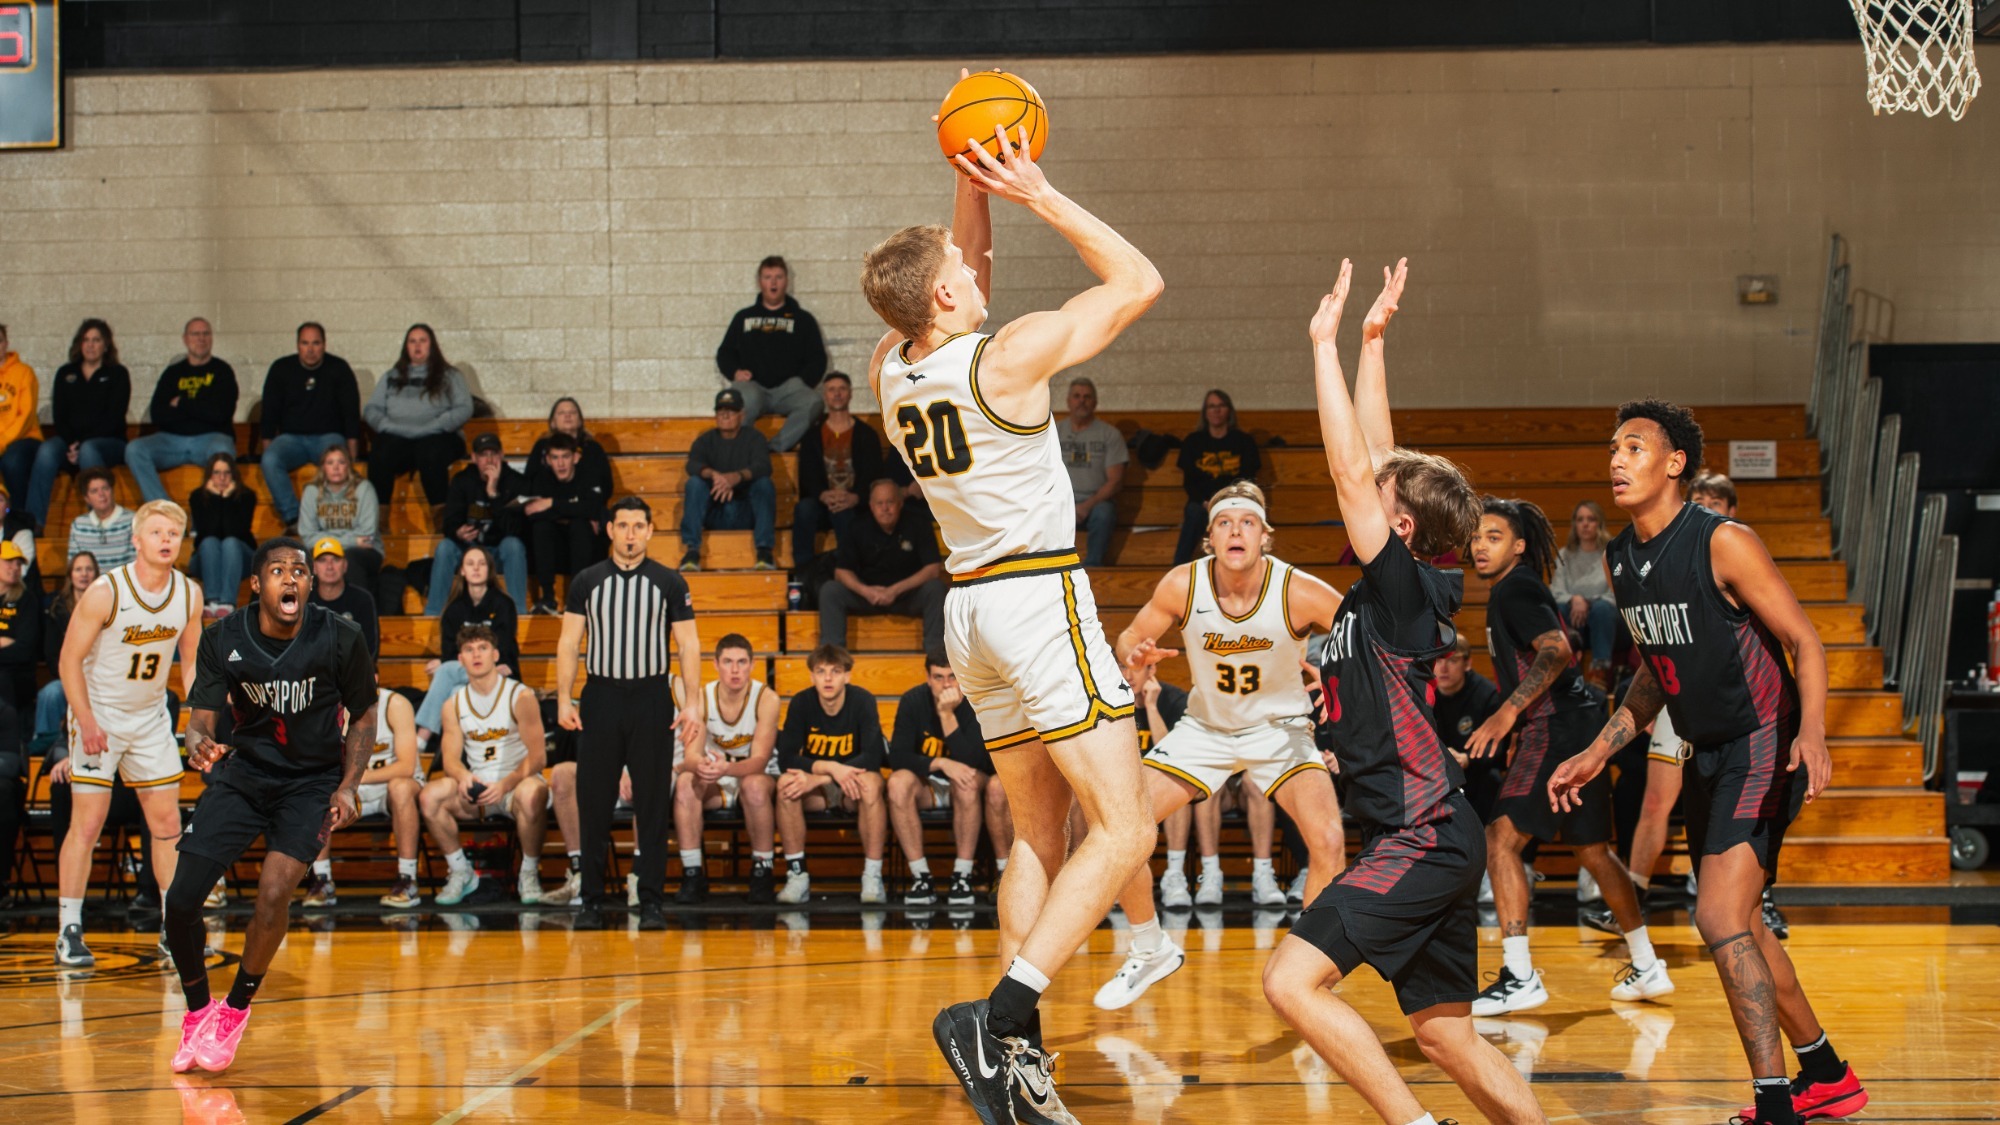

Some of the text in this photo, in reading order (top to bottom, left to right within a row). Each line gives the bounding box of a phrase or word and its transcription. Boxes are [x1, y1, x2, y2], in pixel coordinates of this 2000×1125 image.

[896, 398, 975, 480] 20
[325, 518, 353, 529] TECH
[121, 624, 178, 646] Huskies
[1202, 632, 1274, 657] Huskies
[127, 652, 162, 681] 13
[1215, 661, 1262, 697] 33
[484, 745, 497, 761] 2
[806, 733, 854, 757] MTU
